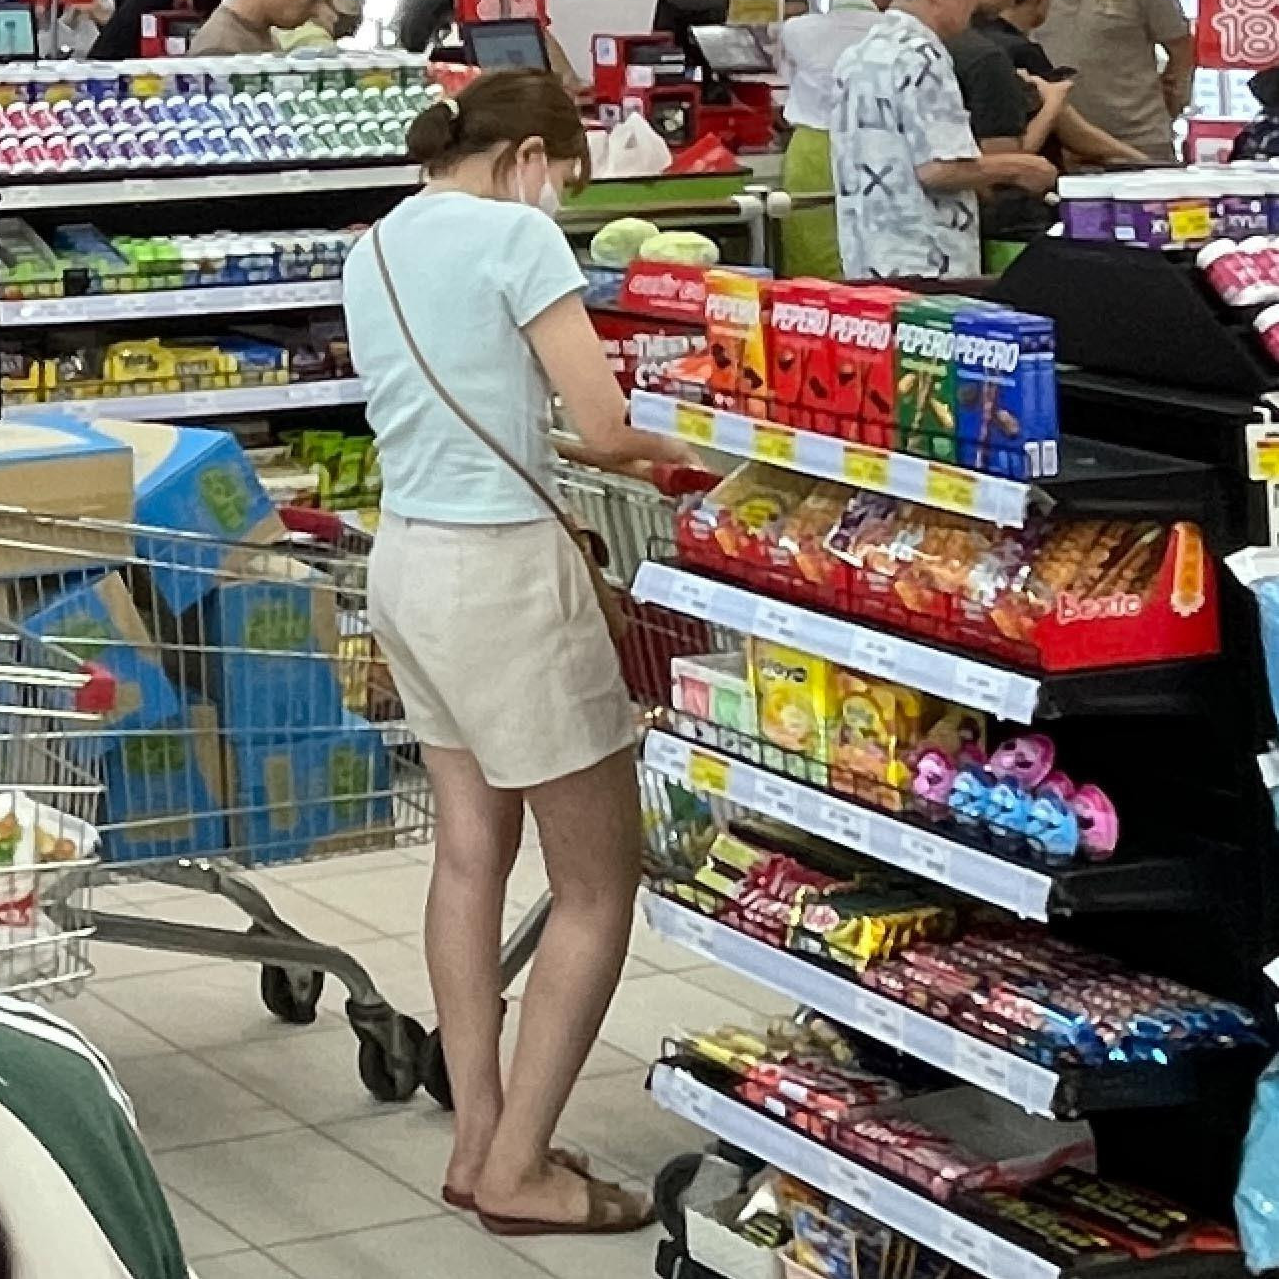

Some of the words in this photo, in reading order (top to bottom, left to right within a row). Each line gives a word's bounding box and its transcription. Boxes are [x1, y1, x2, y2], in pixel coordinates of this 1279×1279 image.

[772, 302, 830, 337] PEPERO
[830, 313, 892, 351] PEPERO
[896, 322, 956, 361] PEPERO
[955, 334, 1020, 373] PEPERO
